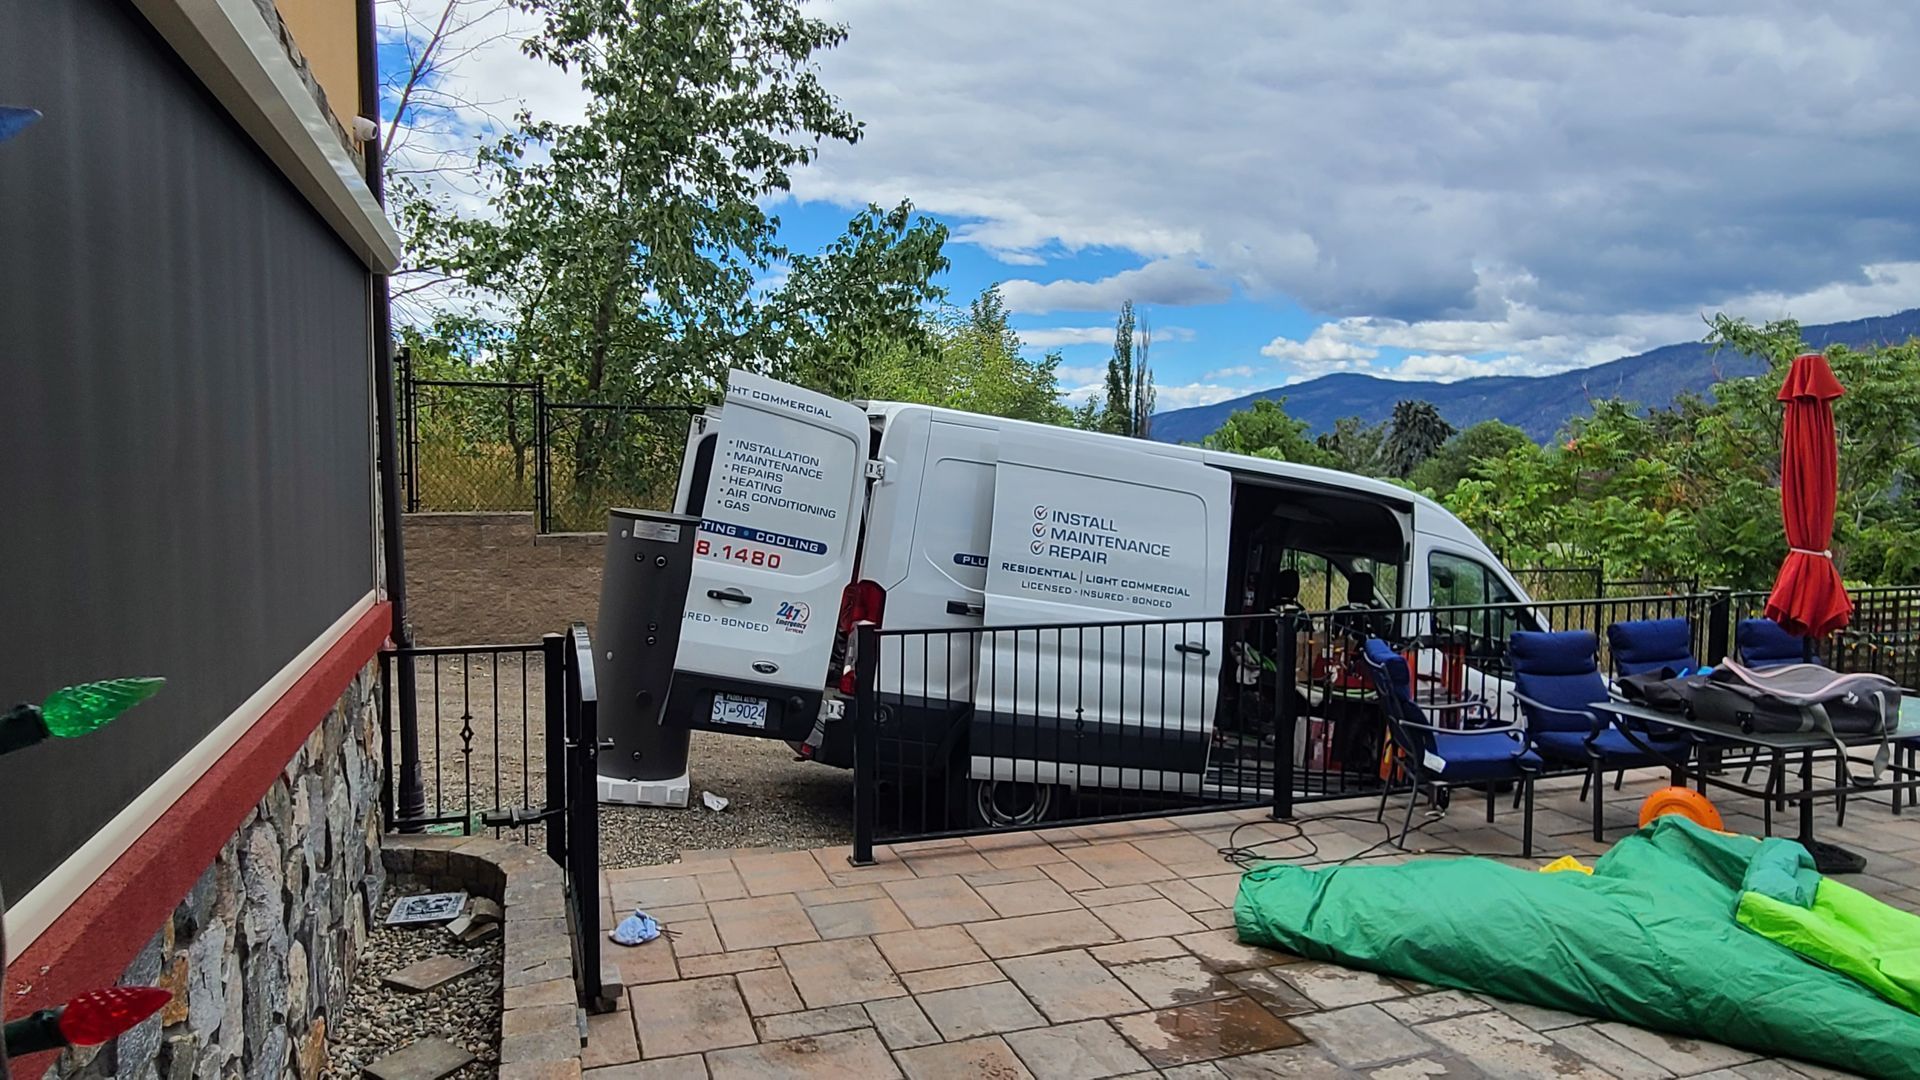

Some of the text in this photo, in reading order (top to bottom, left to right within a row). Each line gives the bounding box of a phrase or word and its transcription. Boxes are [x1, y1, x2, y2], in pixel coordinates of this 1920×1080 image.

[752, 390, 832, 419] COMMERCIAL
[733, 451, 824, 480] MAINTENANCE
[735, 439, 820, 467] INSTALLATION
[728, 475, 783, 495] HEATING
[731, 463, 784, 483] REPAIRS
[724, 499, 751, 513] GAS
[726, 487, 837, 519] AIR CONDITIONING
[1052, 510, 1118, 533] INSTALL
[699, 520, 737, 536] TING
[755, 532, 819, 553] COOLING
[1050, 527, 1171, 558] MAINTENANCE
[695, 540, 781, 569] 8.1480
[962, 555, 987, 566] PLU
[1048, 544, 1108, 565] REPAIR
[1001, 562, 1190, 597] RESIDENTIAL LIGHT COMMERCIAL
[1021, 580, 1172, 609] LICENSED INSURED BONDED
[721, 617, 769, 632] BONDED
